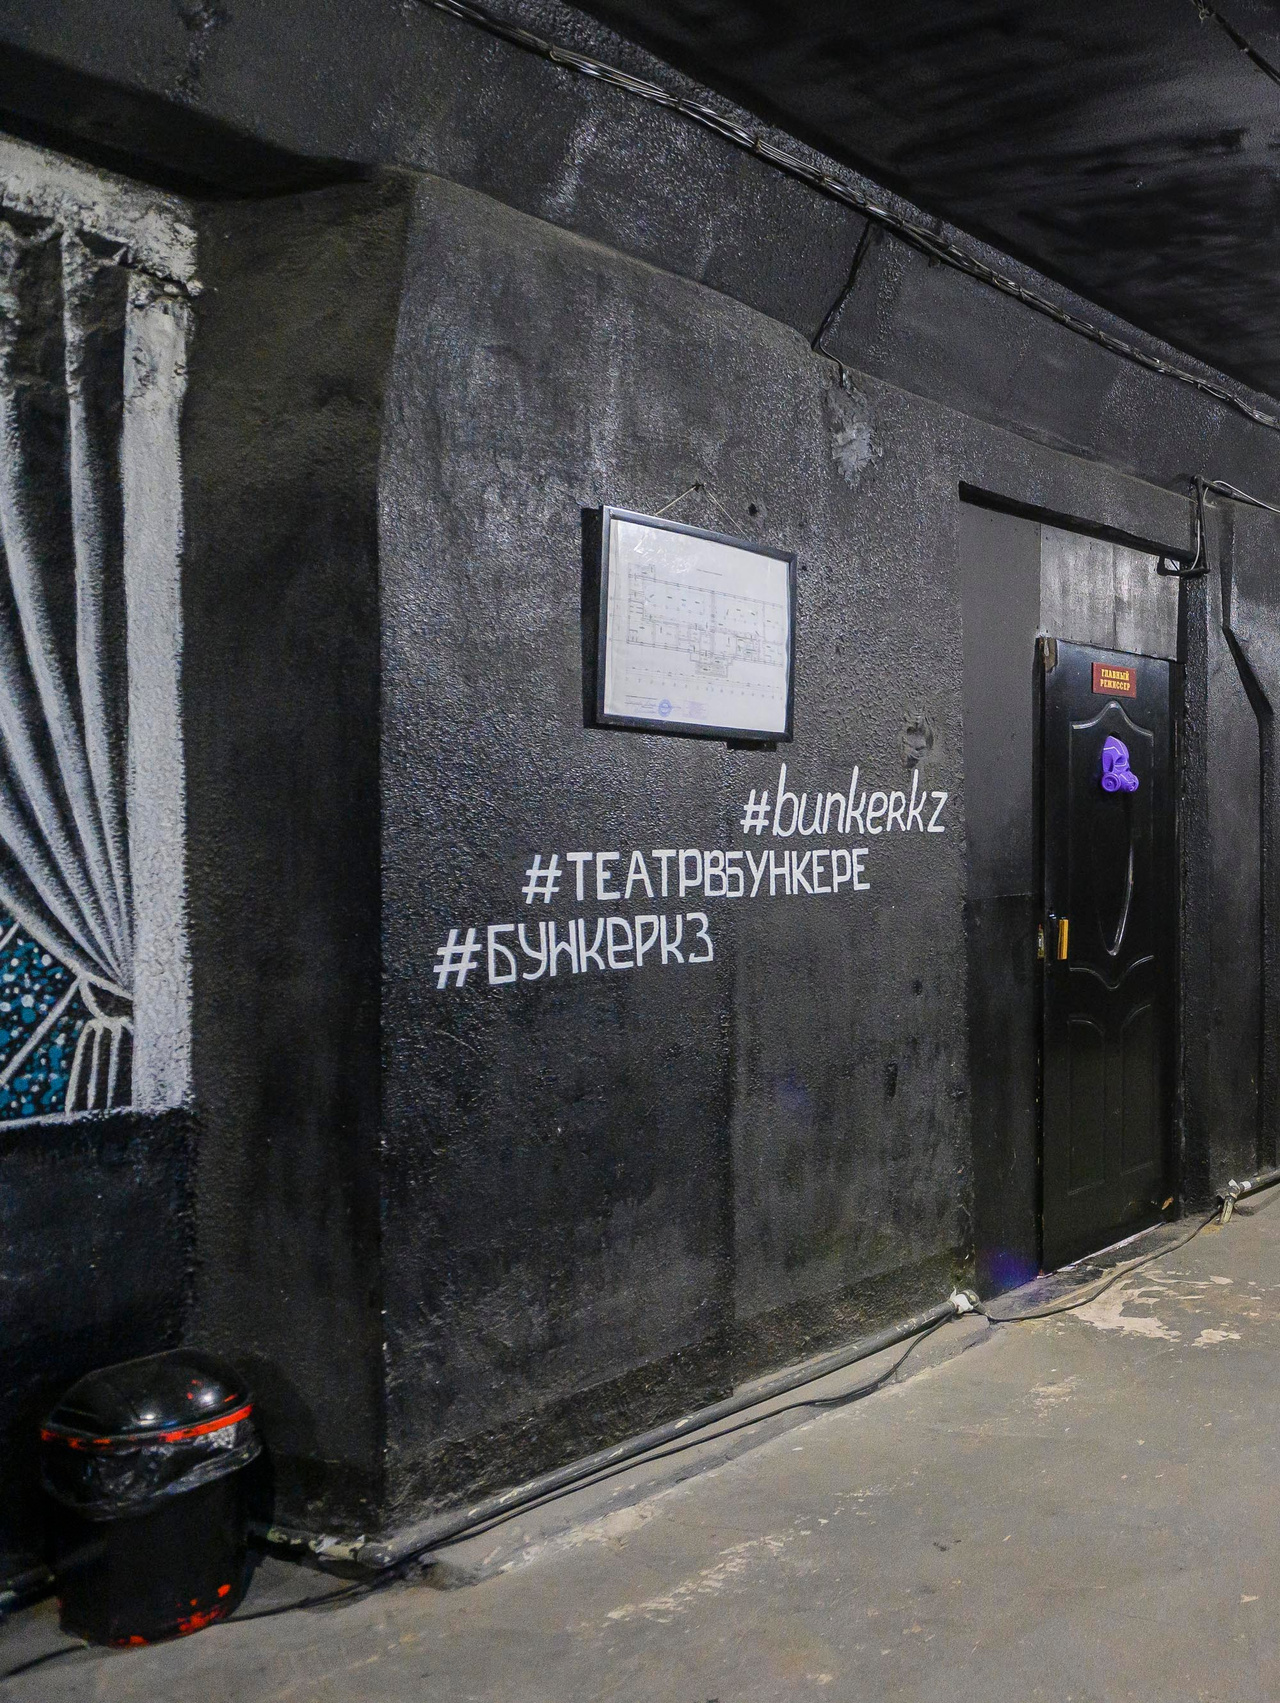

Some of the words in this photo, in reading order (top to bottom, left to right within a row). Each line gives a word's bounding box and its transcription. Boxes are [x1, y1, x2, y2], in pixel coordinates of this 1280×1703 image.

[1100, 679, 1131, 691] РЕЖИССЕР
[1101, 668, 1130, 682] ГЛАВНЫЙ
[740, 763, 948, 837] #bunkerkz
[521, 848, 871, 905] #ТЕАТРВБУНКЕРЕ
